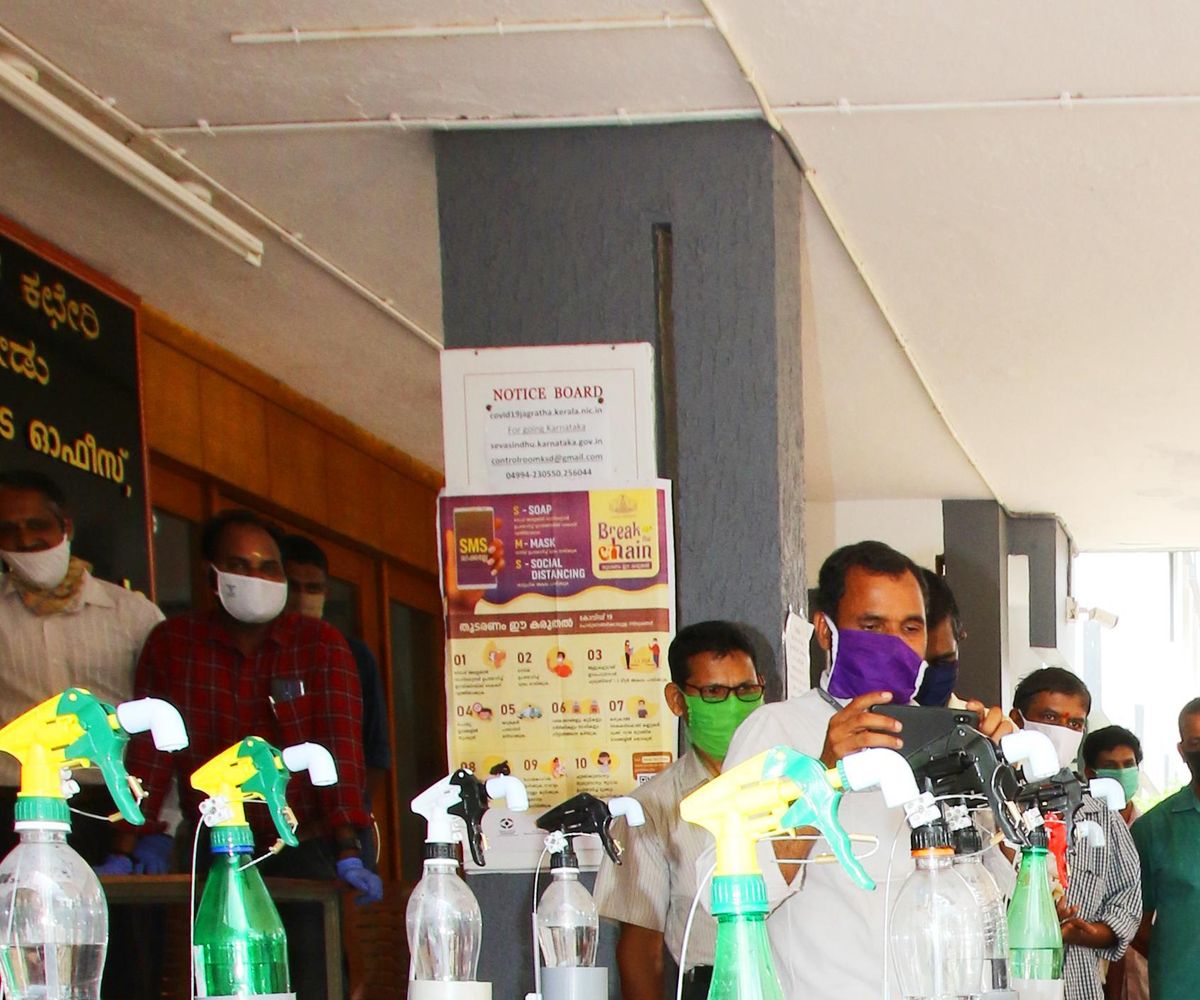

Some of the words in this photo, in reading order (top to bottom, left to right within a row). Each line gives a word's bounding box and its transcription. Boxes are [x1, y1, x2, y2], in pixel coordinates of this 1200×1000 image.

[493, 387, 547, 401] NOTICE
[554, 385, 604, 399] BOARD
[513, 505, 520, 516] S
[528, 504, 552, 515] SOAP
[598, 521, 641, 540] Break
[459, 537, 487, 554] SMS
[515, 539, 523, 549] M
[530, 537, 556, 548] MASK
[598, 537, 652, 561] chain
[515, 559, 522, 569] S
[530, 558, 563, 569] SOCIAL
[531, 568, 586, 580] DISTANCING
[454, 654, 466, 666] 01
[517, 652, 532, 664] 02
[587, 649, 602, 661] 03
[457, 705, 473, 717] 04
[500, 703, 516, 715] 05
[552, 702, 567, 713] 06
[609, 700, 624, 712] 07
[524, 759, 538, 771] 09
[575, 757, 587, 769] 10
